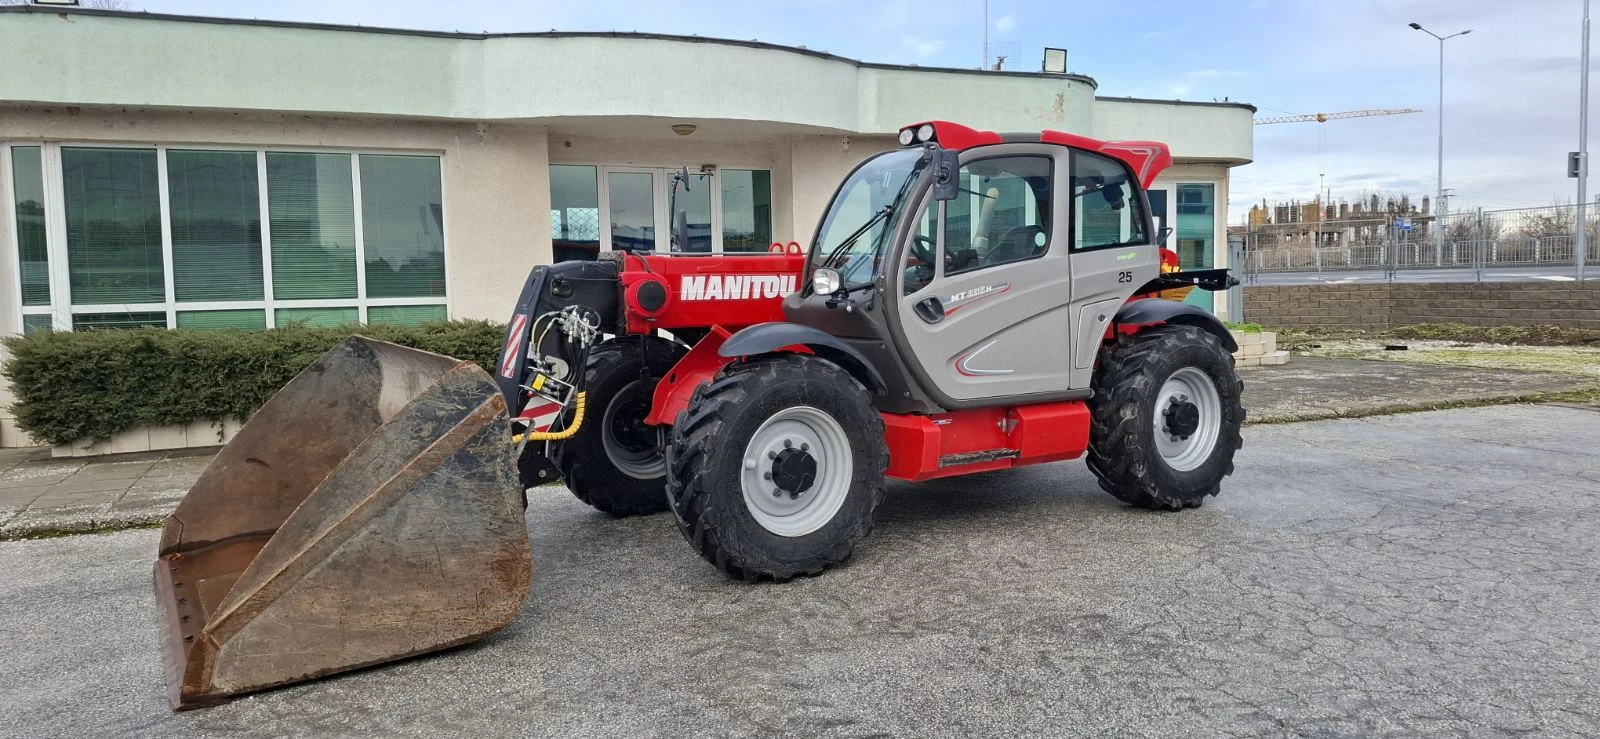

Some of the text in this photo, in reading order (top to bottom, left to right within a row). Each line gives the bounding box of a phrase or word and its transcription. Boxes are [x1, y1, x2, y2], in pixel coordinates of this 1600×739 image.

[1119, 271, 1132, 282] 25
[681, 275, 796, 300] MANITOU
[951, 291, 967, 302] MT
